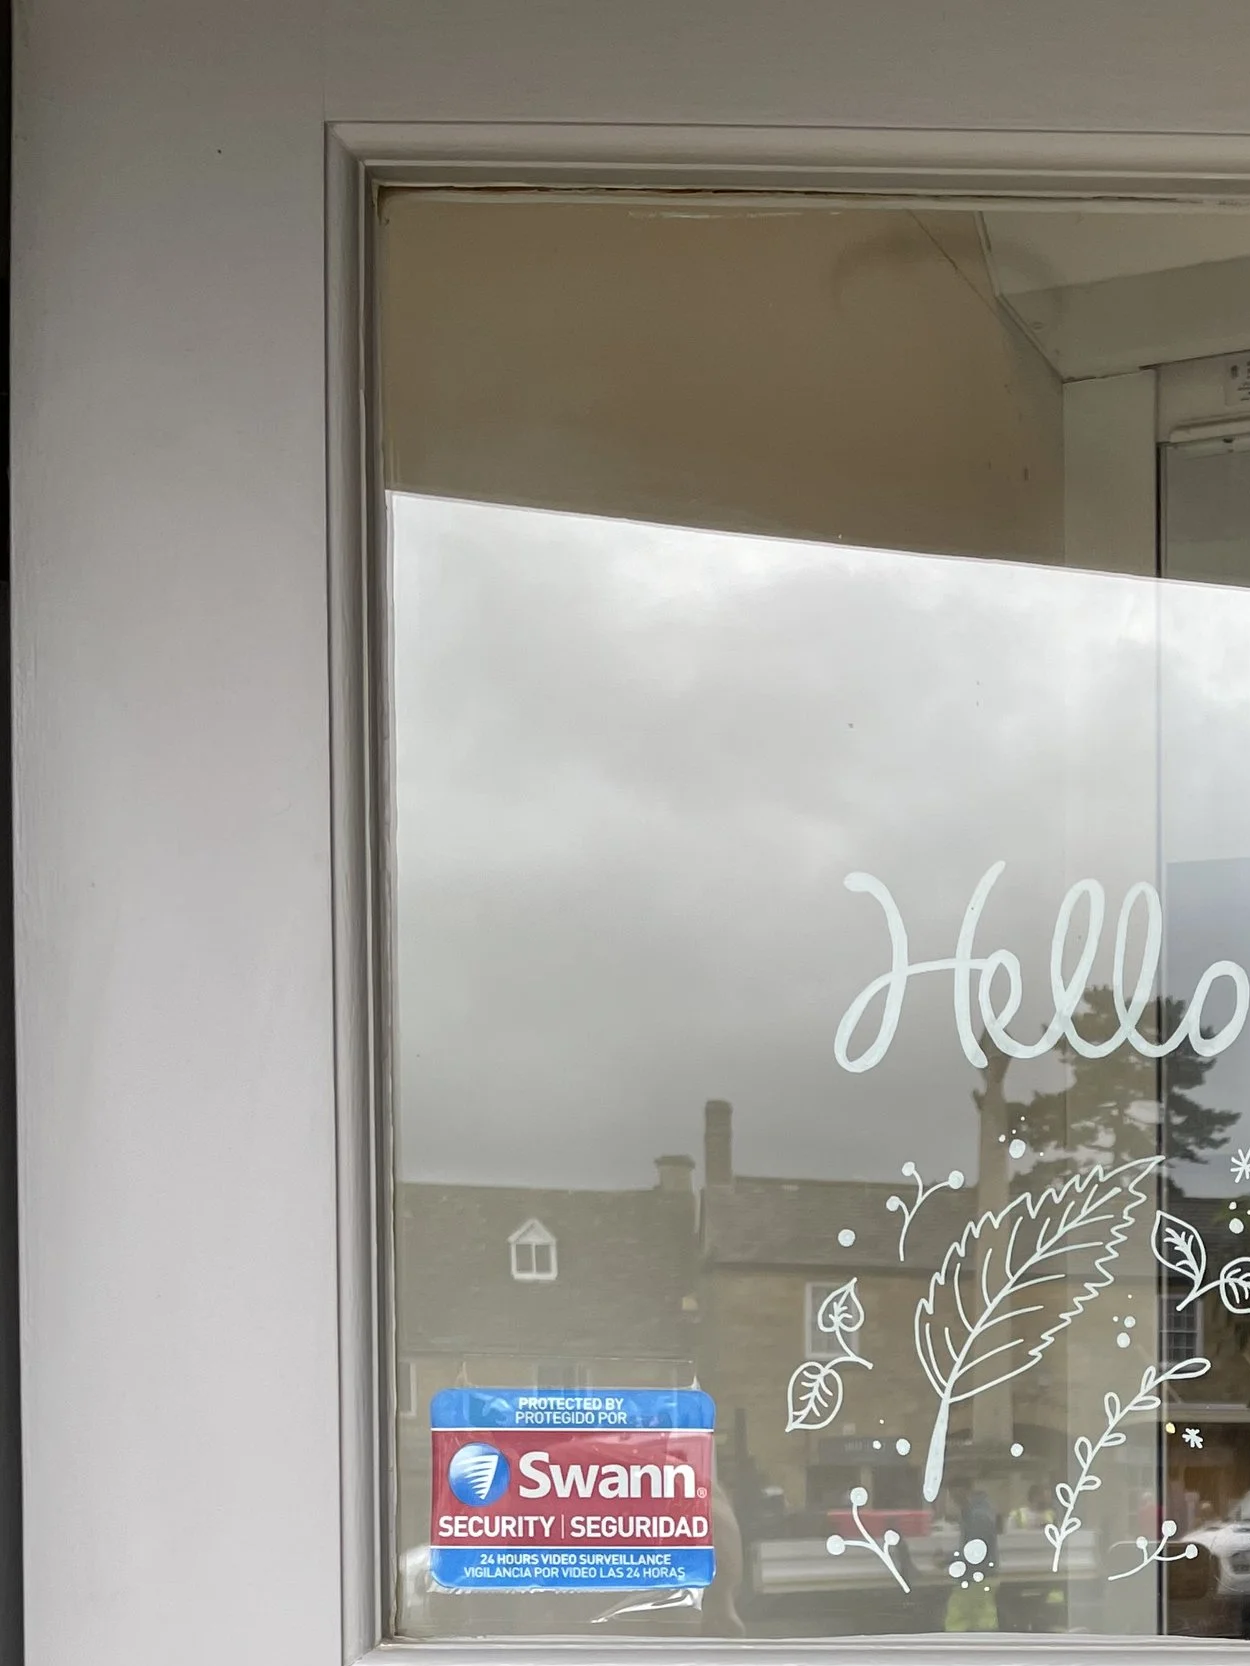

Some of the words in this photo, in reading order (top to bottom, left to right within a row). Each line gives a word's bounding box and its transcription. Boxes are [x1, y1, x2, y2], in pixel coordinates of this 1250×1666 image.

[834, 861, 1250, 1072] Hello
[518, 1397, 602, 1410] PROTECTED
[605, 1397, 624, 1411] BY
[515, 1411, 595, 1424] PROTEGIDO
[598, 1412, 627, 1424] POR
[438, 1515, 555, 1538] SECURITY
[570, 1516, 709, 1538] SEGURIDAD
[480, 1554, 495, 1564] 24
[497, 1554, 539, 1564] HOURS
[541, 1554, 577, 1564] VIDEO
[579, 1554, 672, 1565] SURVEILLANCE
[463, 1567, 532, 1578] VIGILANCIA
[534, 1567, 560, 1578] POR
[561, 1567, 597, 1578] VIDEO
[600, 1567, 624, 1578] LAS
[626, 1567, 640, 1578] 24
[643, 1567, 686, 1578] HORAS
